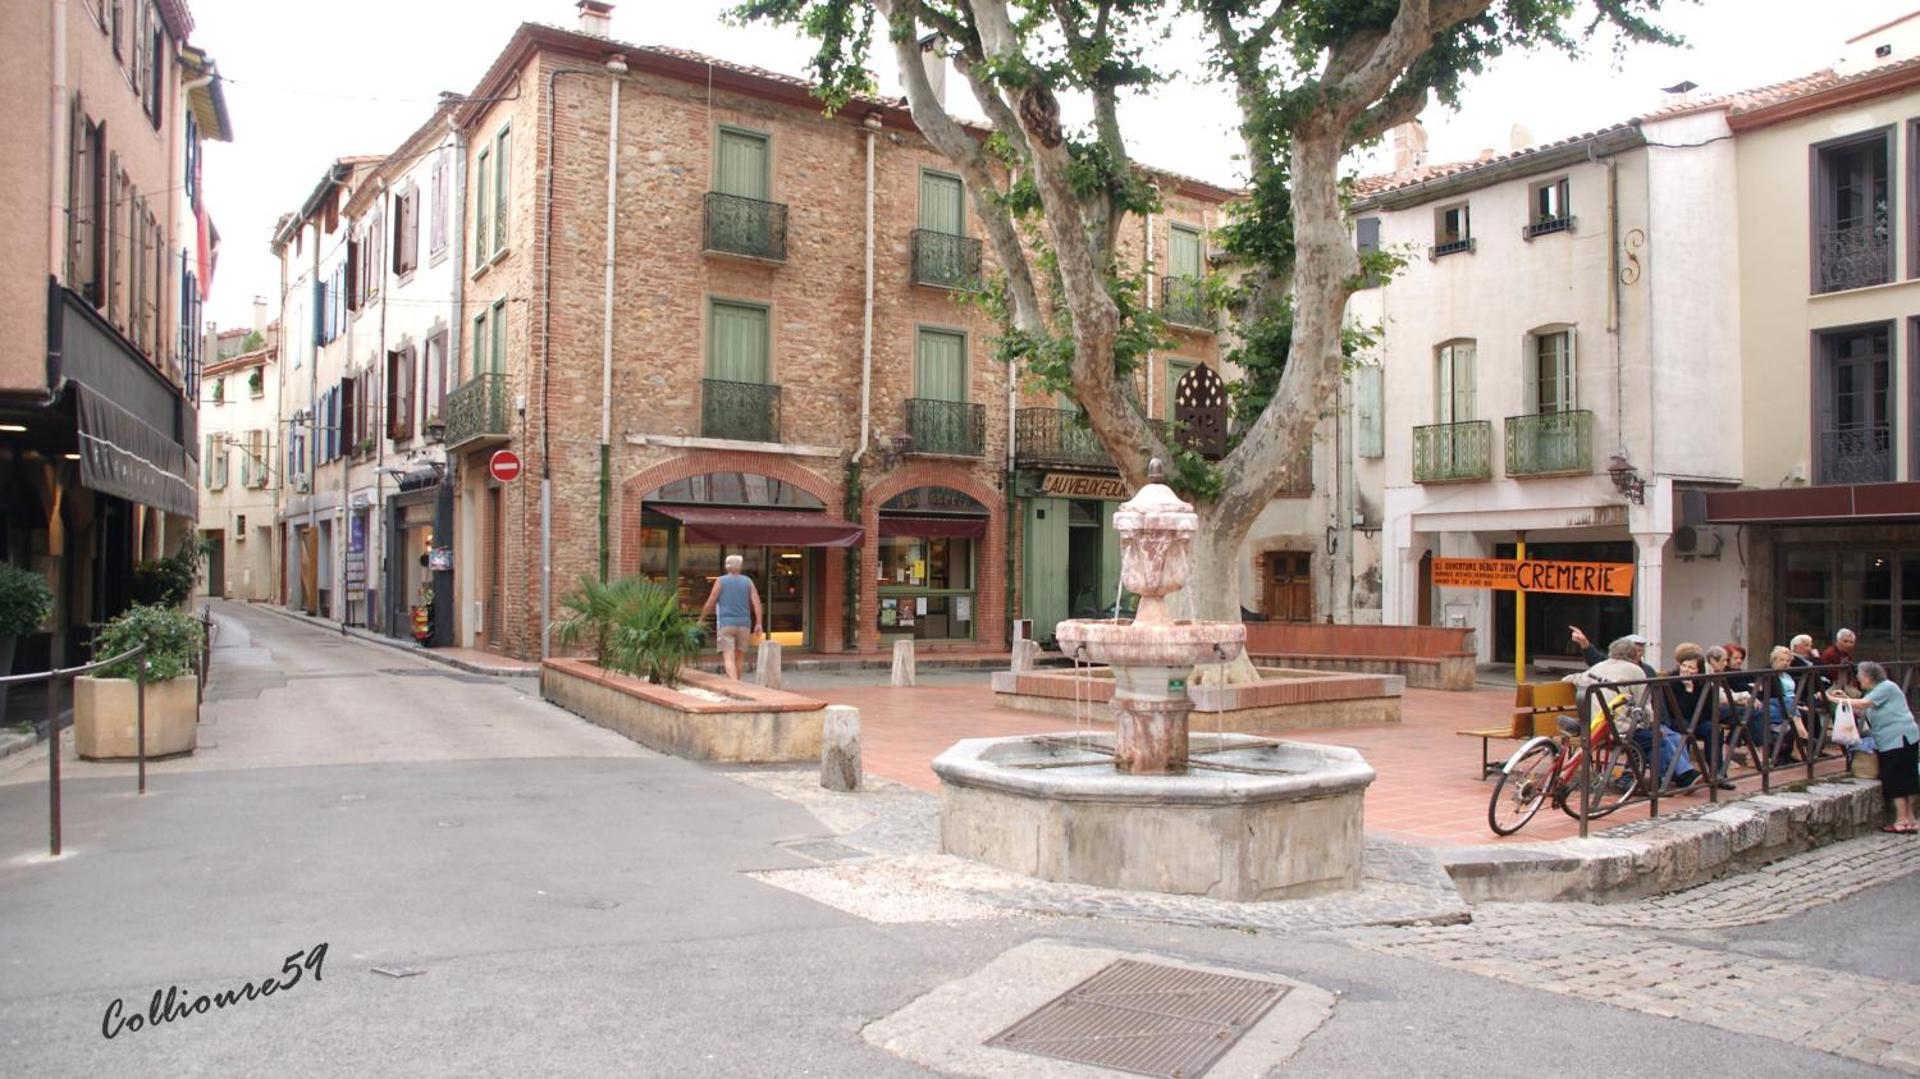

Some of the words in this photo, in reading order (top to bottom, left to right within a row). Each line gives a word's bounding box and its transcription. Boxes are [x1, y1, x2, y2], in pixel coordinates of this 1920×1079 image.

[1049, 476, 1068, 494] AU
[1067, 478, 1102, 495] VIEUX
[1444, 562, 1477, 571] OUVERTURE
